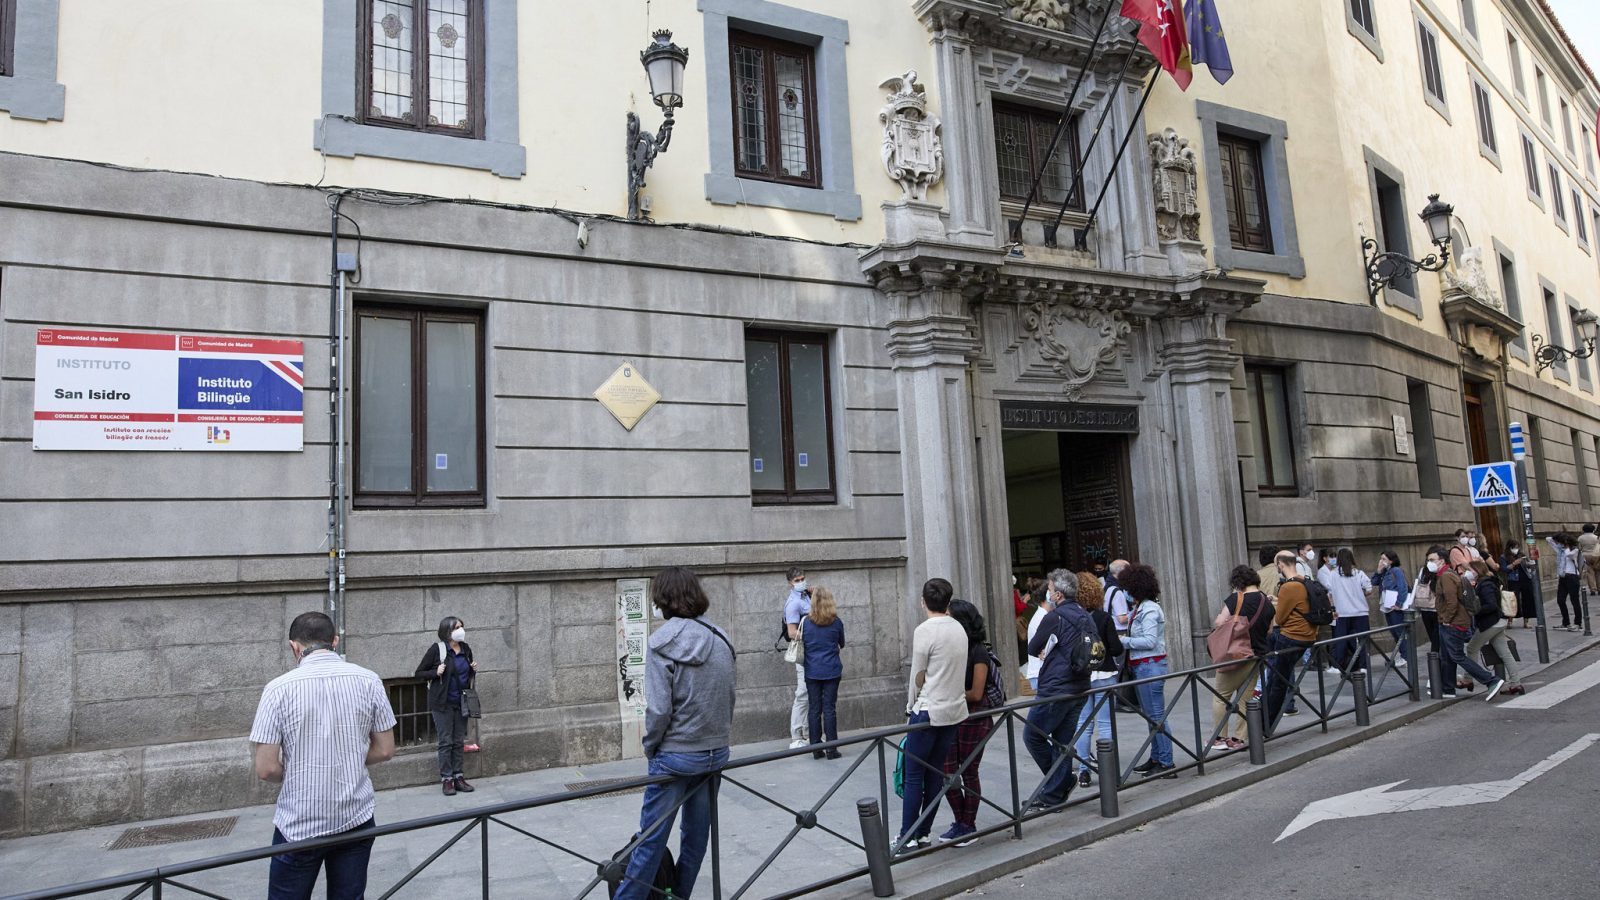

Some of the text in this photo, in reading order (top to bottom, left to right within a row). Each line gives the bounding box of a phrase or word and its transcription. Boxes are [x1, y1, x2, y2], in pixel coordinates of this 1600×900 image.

[57, 358, 131, 370] INSTITUTO
[197, 376, 253, 389] Instituto
[54, 388, 131, 401] San Isidro
[197, 391, 251, 405] Bilingüe
[54, 412, 89, 420] CONSEJERÍA
[237, 415, 265, 423] EDUCACIÓN
[1003, 408, 1067, 424] INSTITUTO
